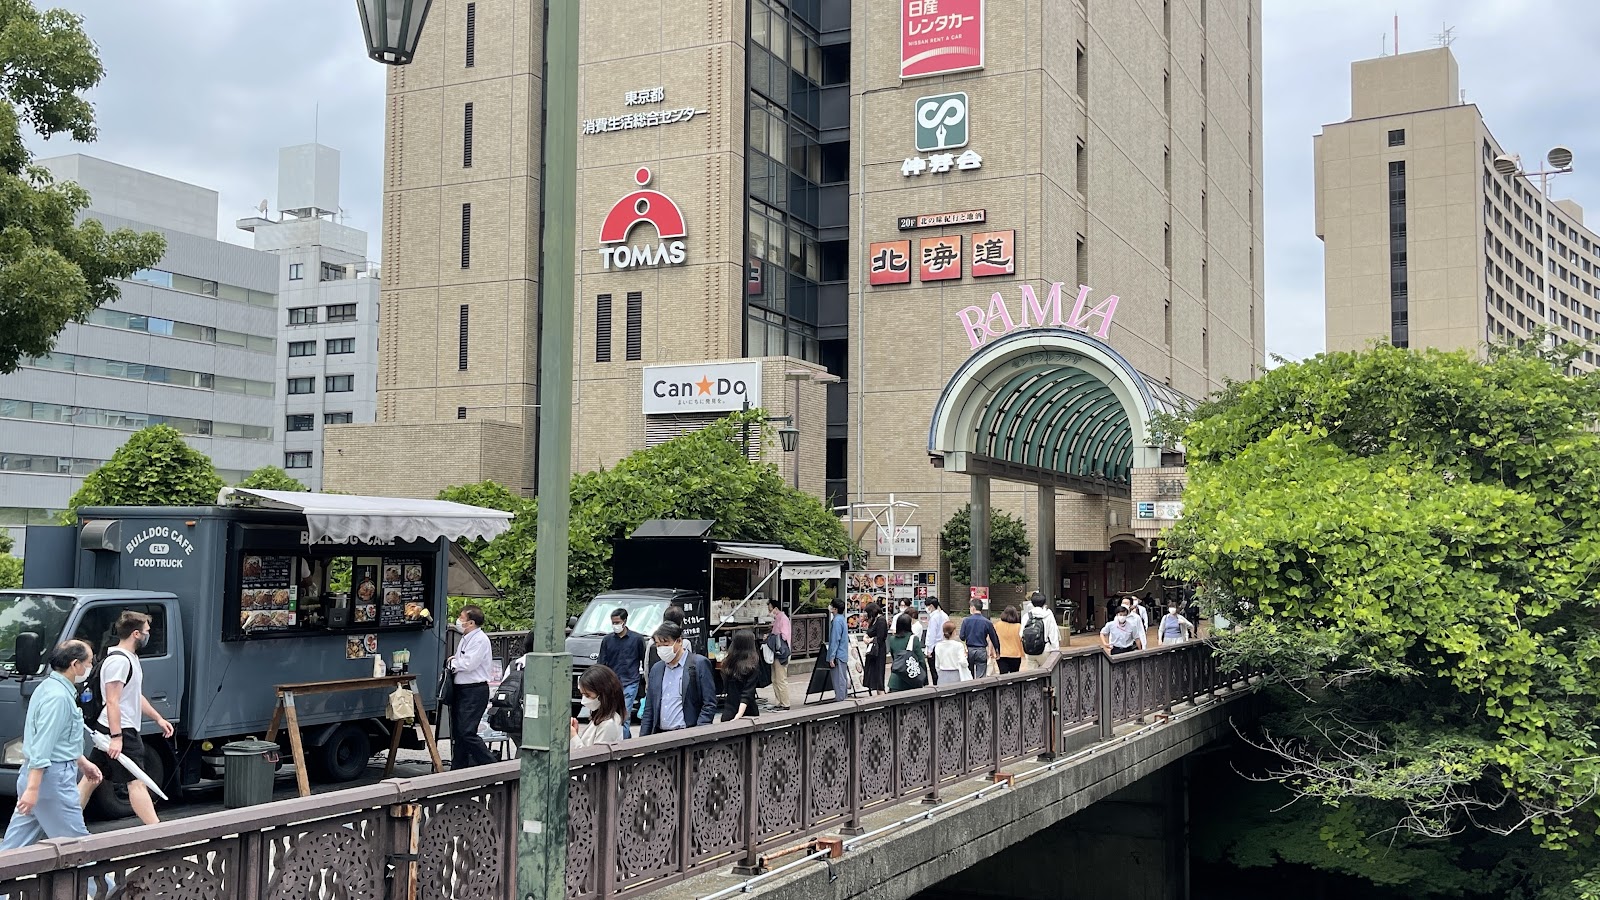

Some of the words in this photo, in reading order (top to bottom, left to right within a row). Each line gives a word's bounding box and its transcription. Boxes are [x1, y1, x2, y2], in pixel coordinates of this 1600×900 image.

[909, 0, 938, 17] 日産
[909, 13, 974, 36] レンタカー
[625, 86, 664, 106] 東京都
[582, 107, 708, 134] 消費生活総合センター
[900, 219, 916, 228] 20F
[598, 240, 686, 269] TOMAS
[872, 238, 1011, 272] 北海道
[653, 380, 693, 398] Can
[717, 378, 747, 396] Do
[125, 526, 169, 554] BULLDOG
[170, 530, 194, 556] CAFE
[133, 558, 156, 567] FOOD
[155, 559, 183, 568] TRUCK
